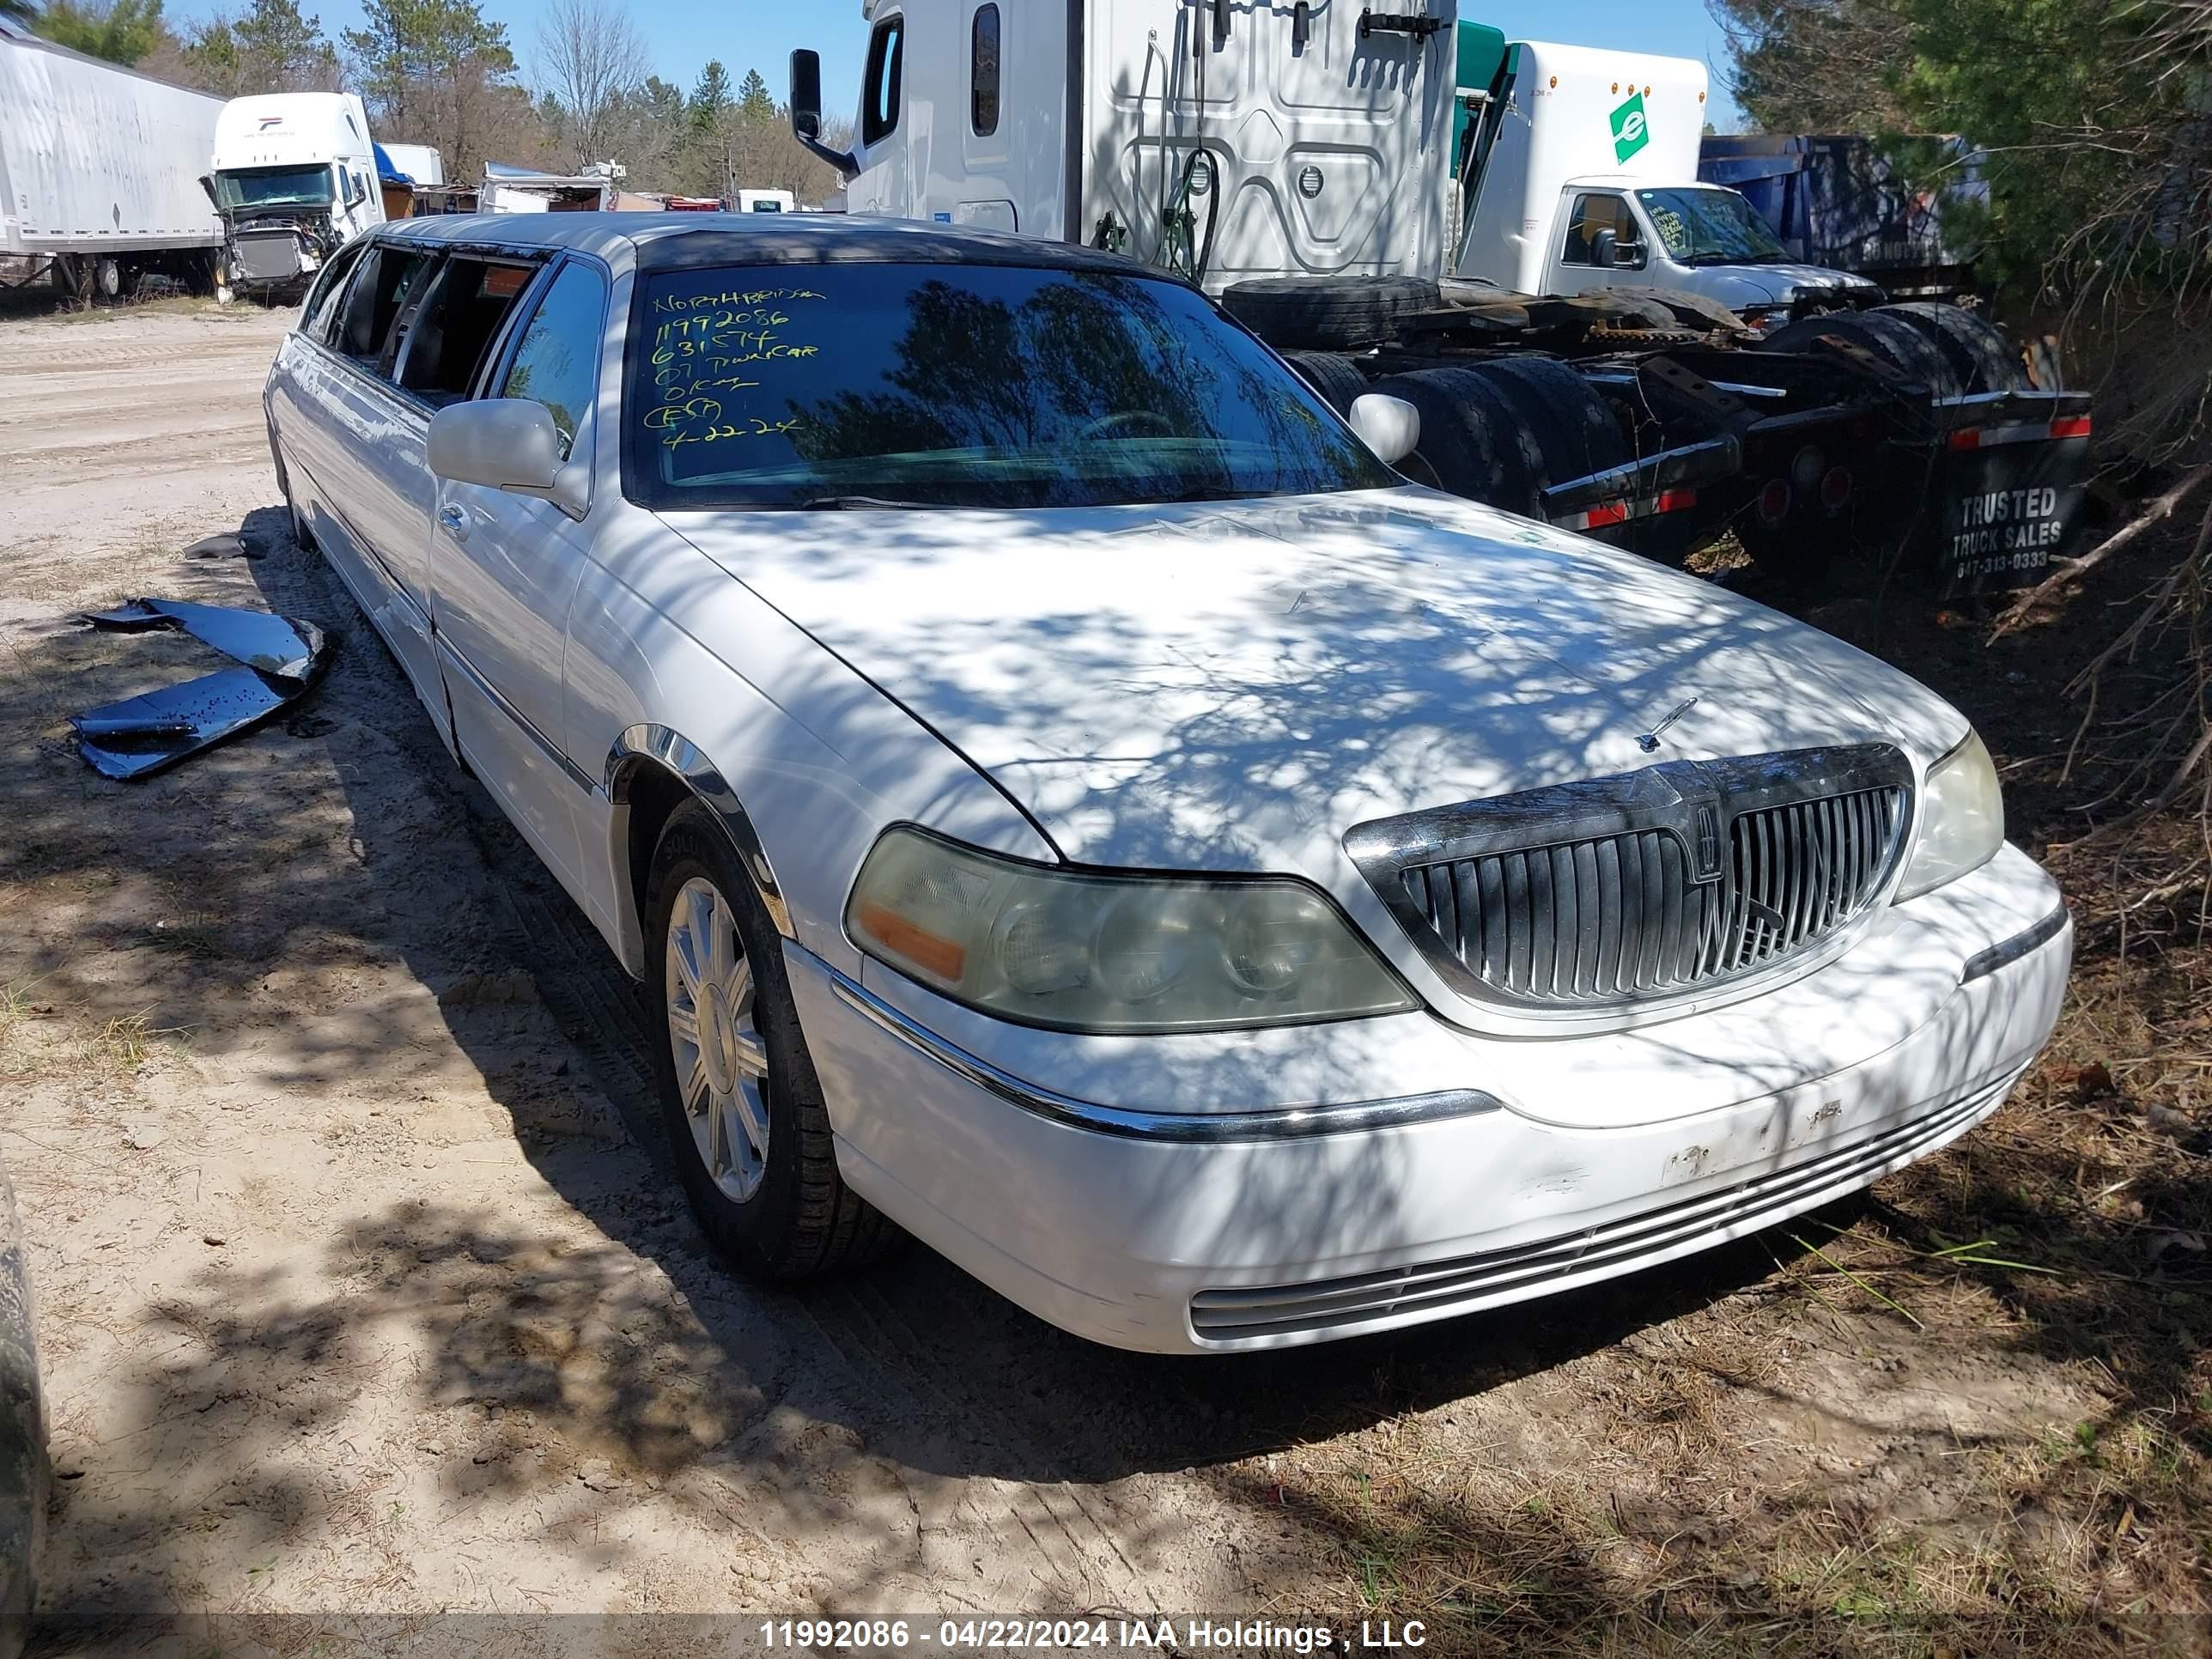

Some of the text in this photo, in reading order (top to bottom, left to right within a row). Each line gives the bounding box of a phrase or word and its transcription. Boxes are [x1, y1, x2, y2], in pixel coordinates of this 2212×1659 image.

[655, 308, 789, 346] 11992086
[651, 330, 779, 365] 631574
[1963, 487, 2057, 526] TRUSTED
[1954, 520, 2061, 558] TRUCK SALES
[1957, 550, 2048, 578] 647-313-0333
